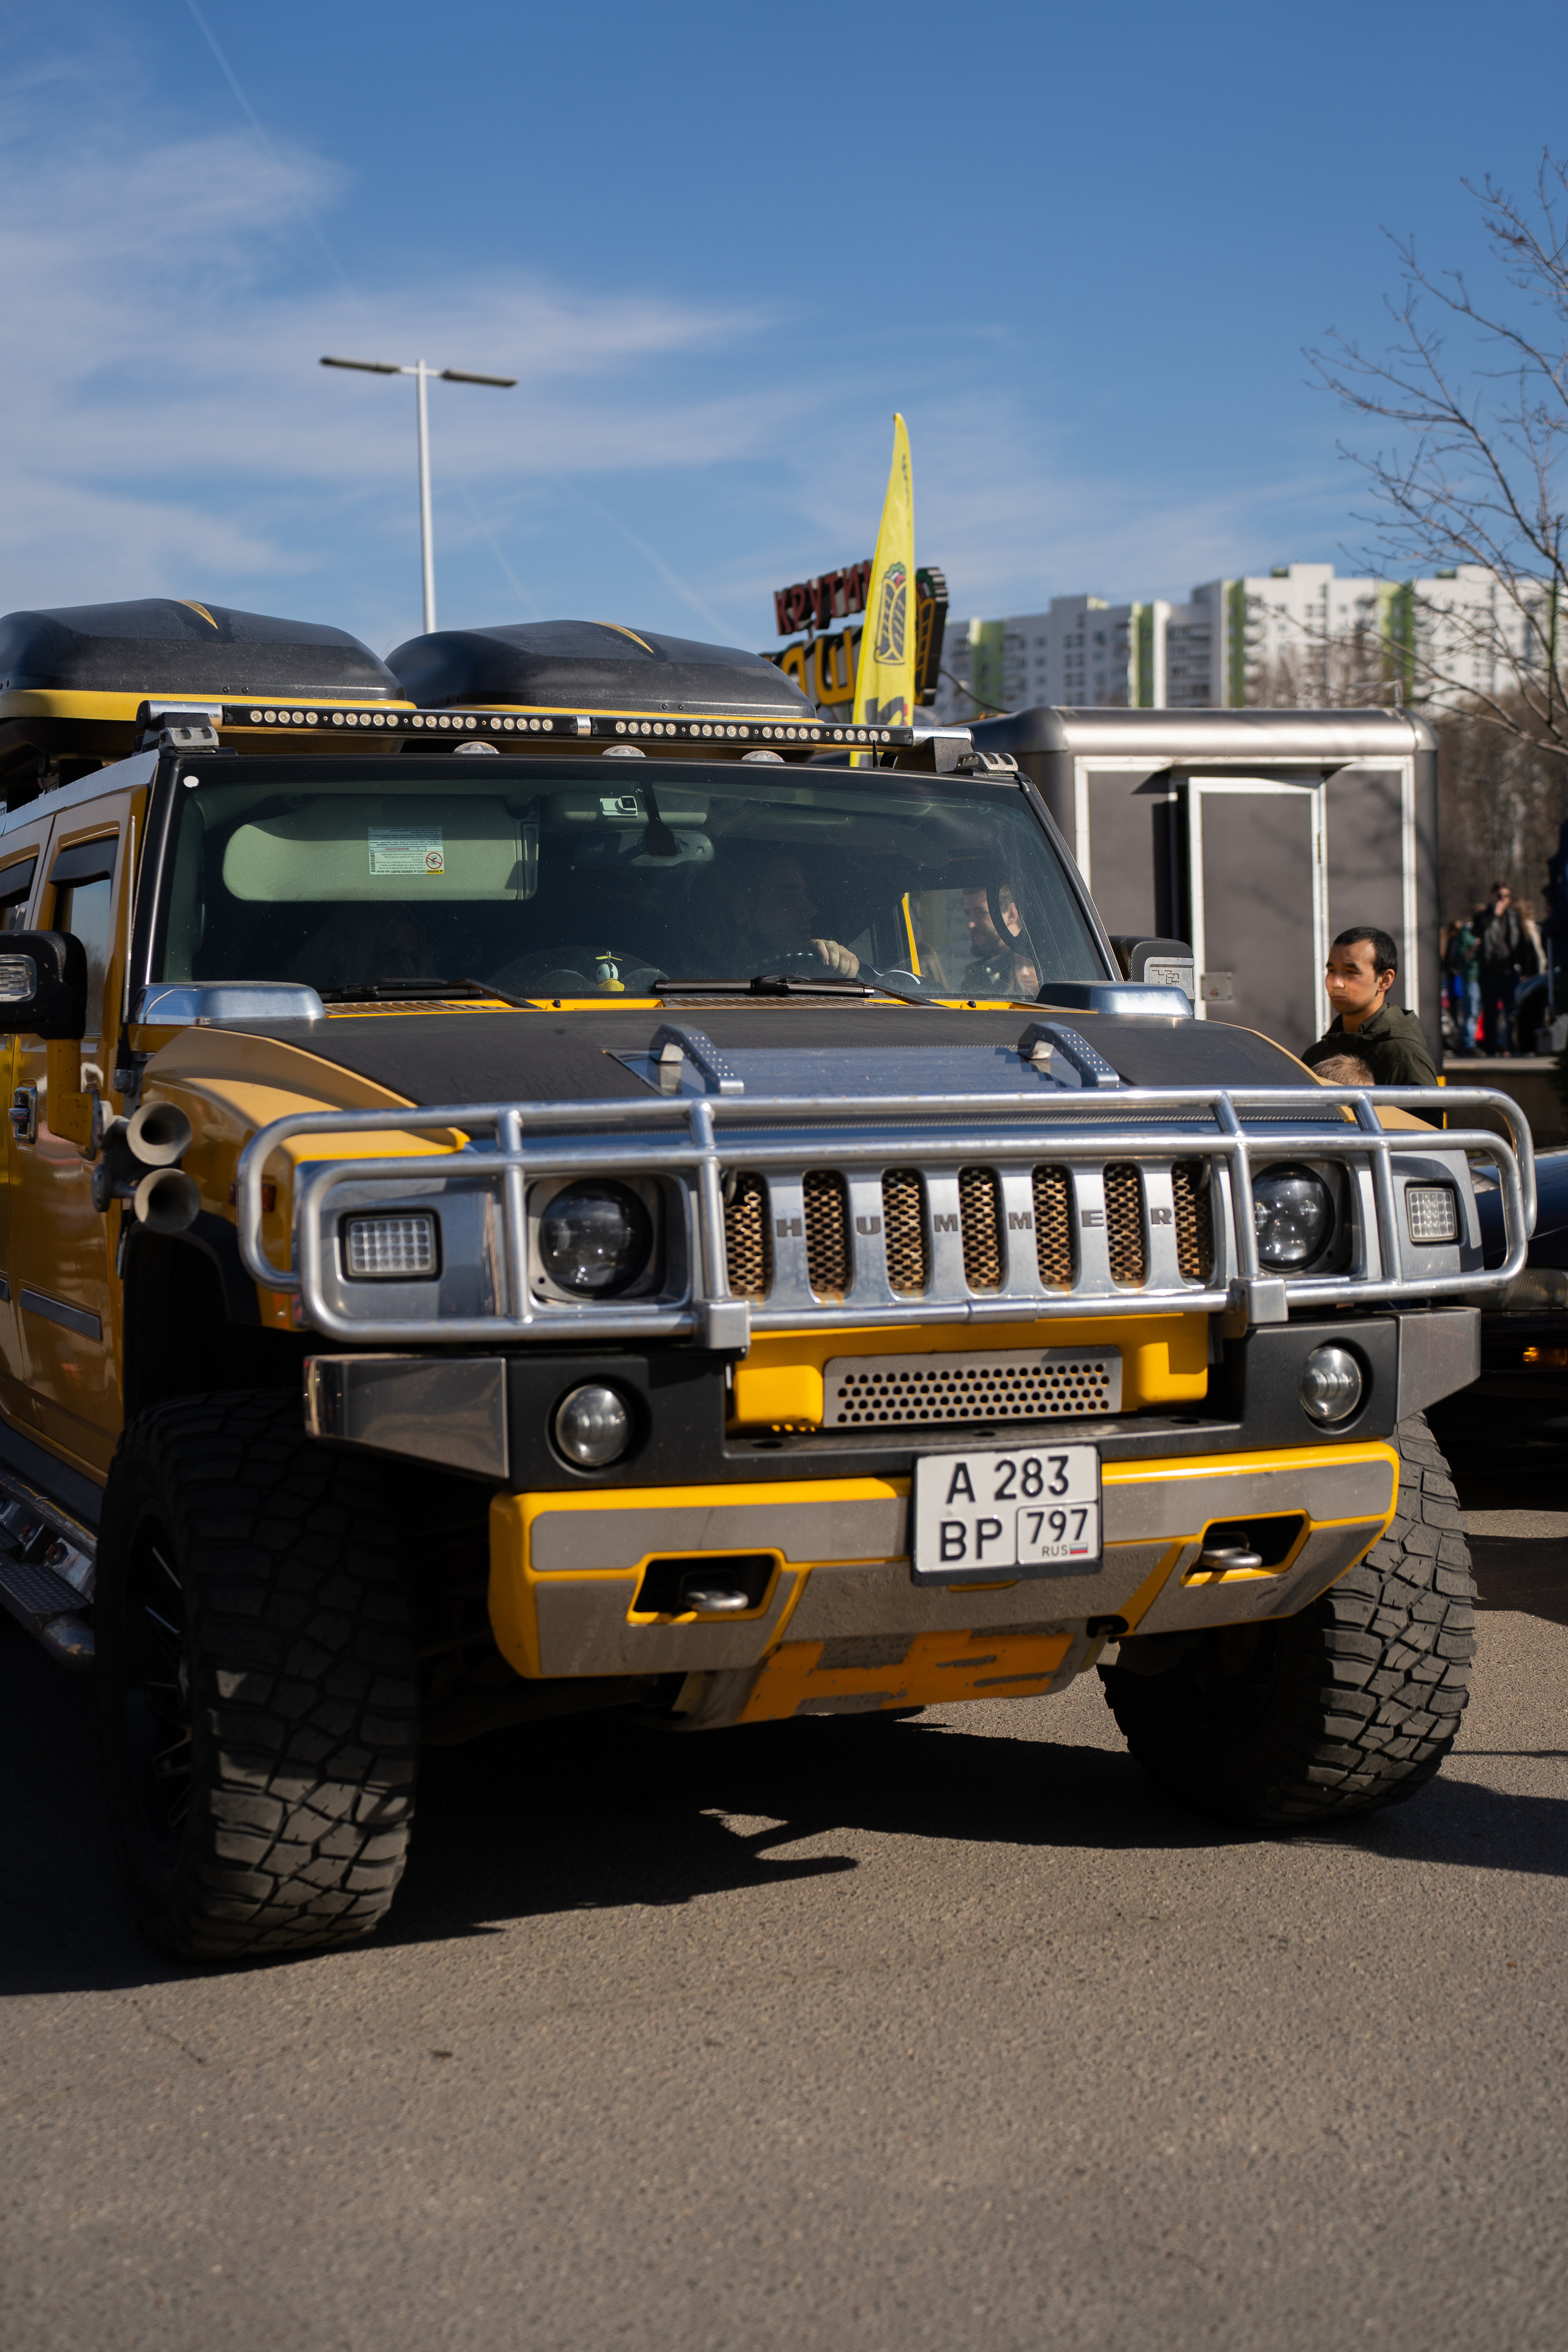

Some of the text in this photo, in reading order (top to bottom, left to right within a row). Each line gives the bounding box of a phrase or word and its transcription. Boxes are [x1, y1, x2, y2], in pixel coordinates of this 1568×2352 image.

[774, 559, 873, 636] КРУТИ
[776, 1208, 1172, 1238] HUMMER
[993, 1455, 1069, 1501] 283
[1027, 1509, 1088, 1544] 797
[1042, 1544, 1068, 1557] RUS
